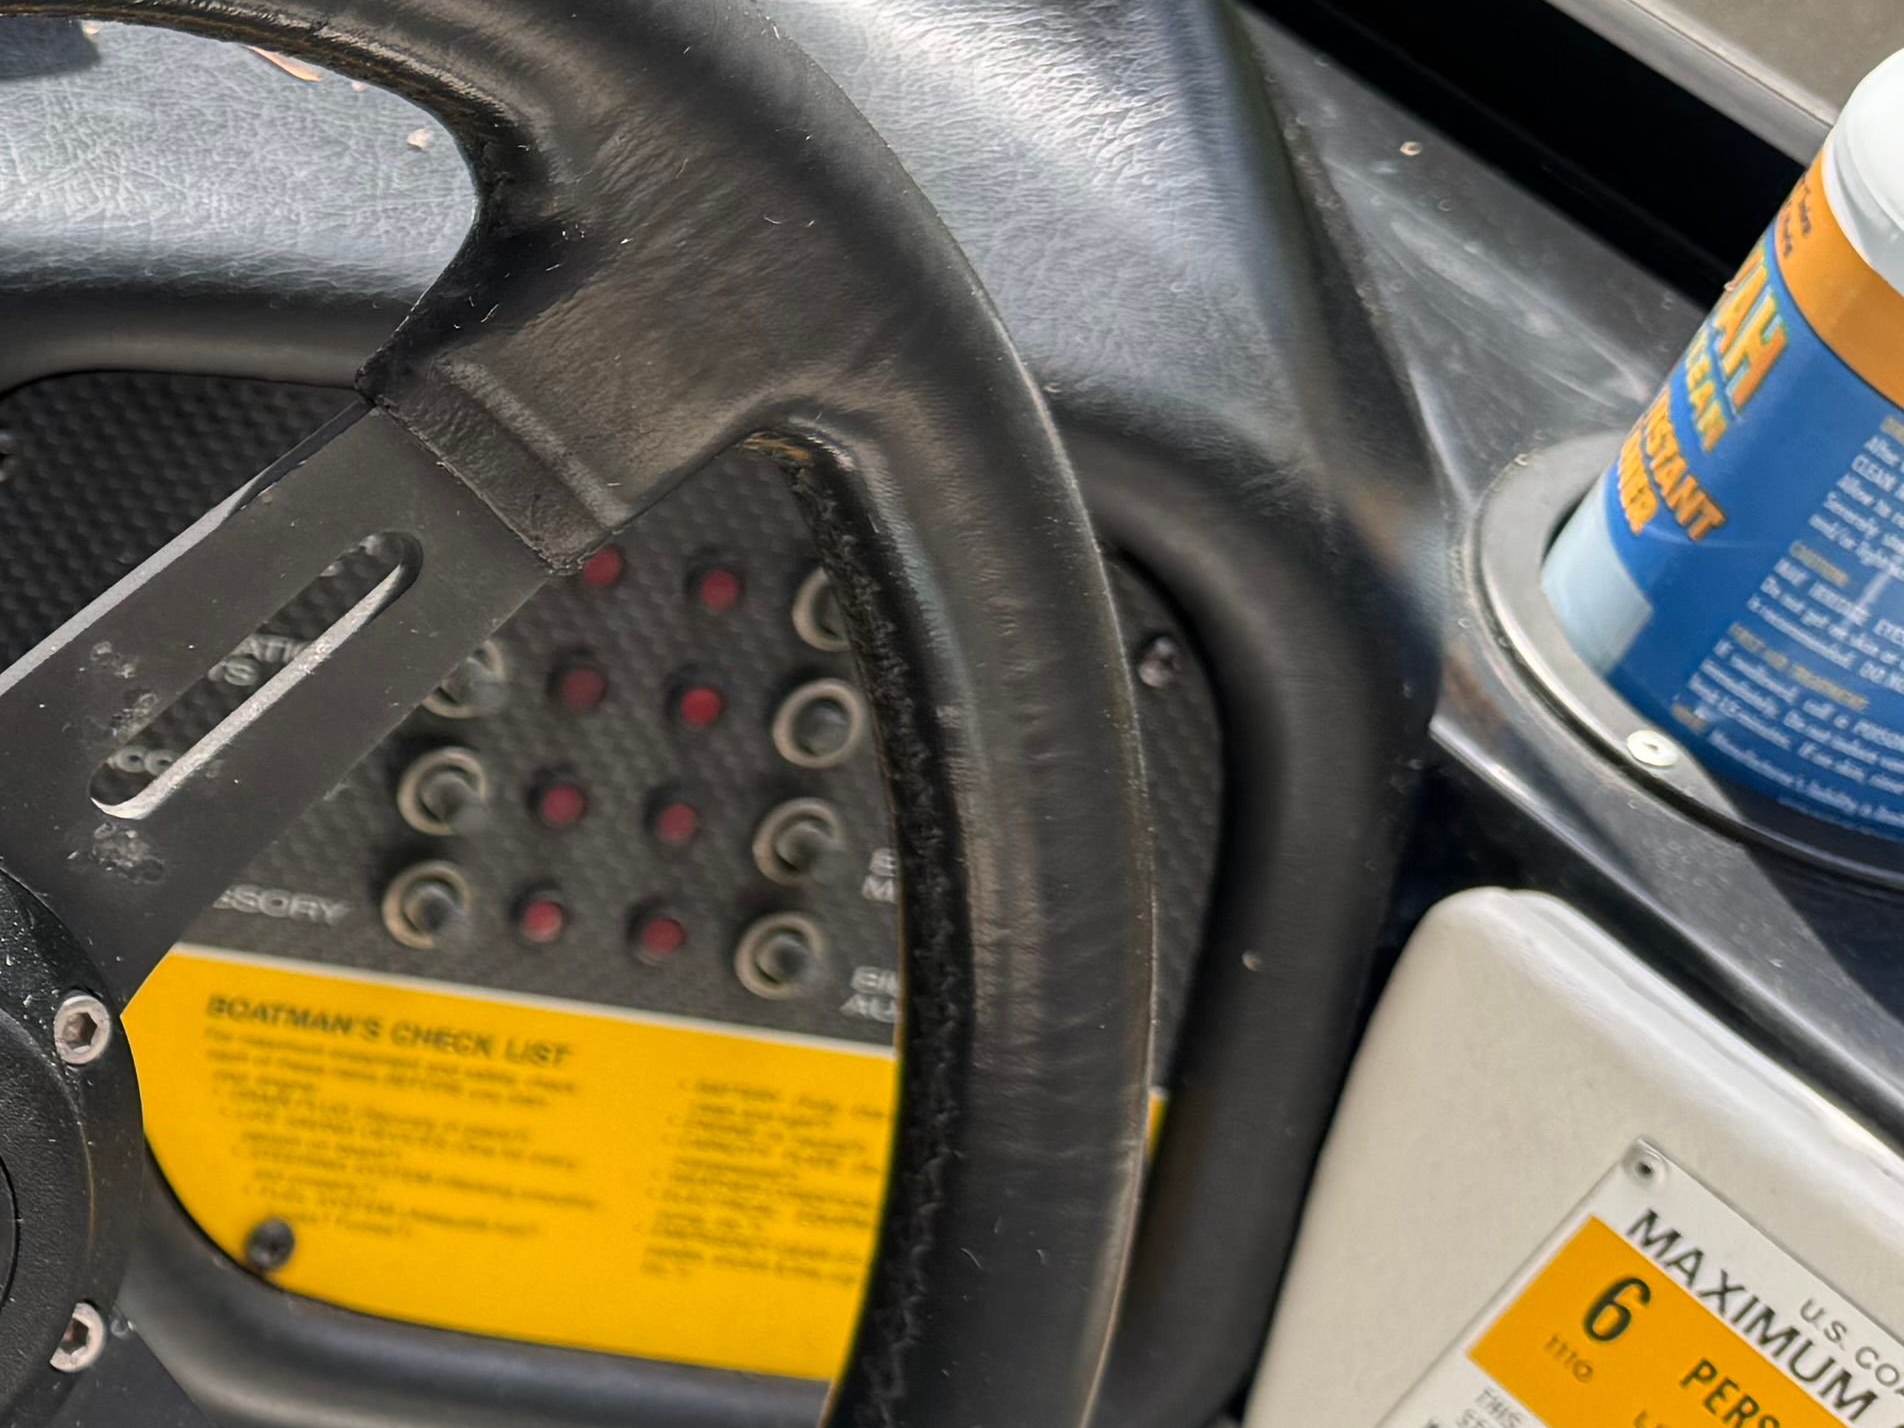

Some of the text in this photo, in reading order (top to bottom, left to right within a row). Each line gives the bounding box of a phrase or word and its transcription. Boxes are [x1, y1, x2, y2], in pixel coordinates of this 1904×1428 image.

[392, 1021, 496, 1059] CHECK
[505, 1038, 572, 1068] LIST
[1582, 1276, 1652, 1343] 6
[1626, 1208, 1878, 1423] MAXIMUM
